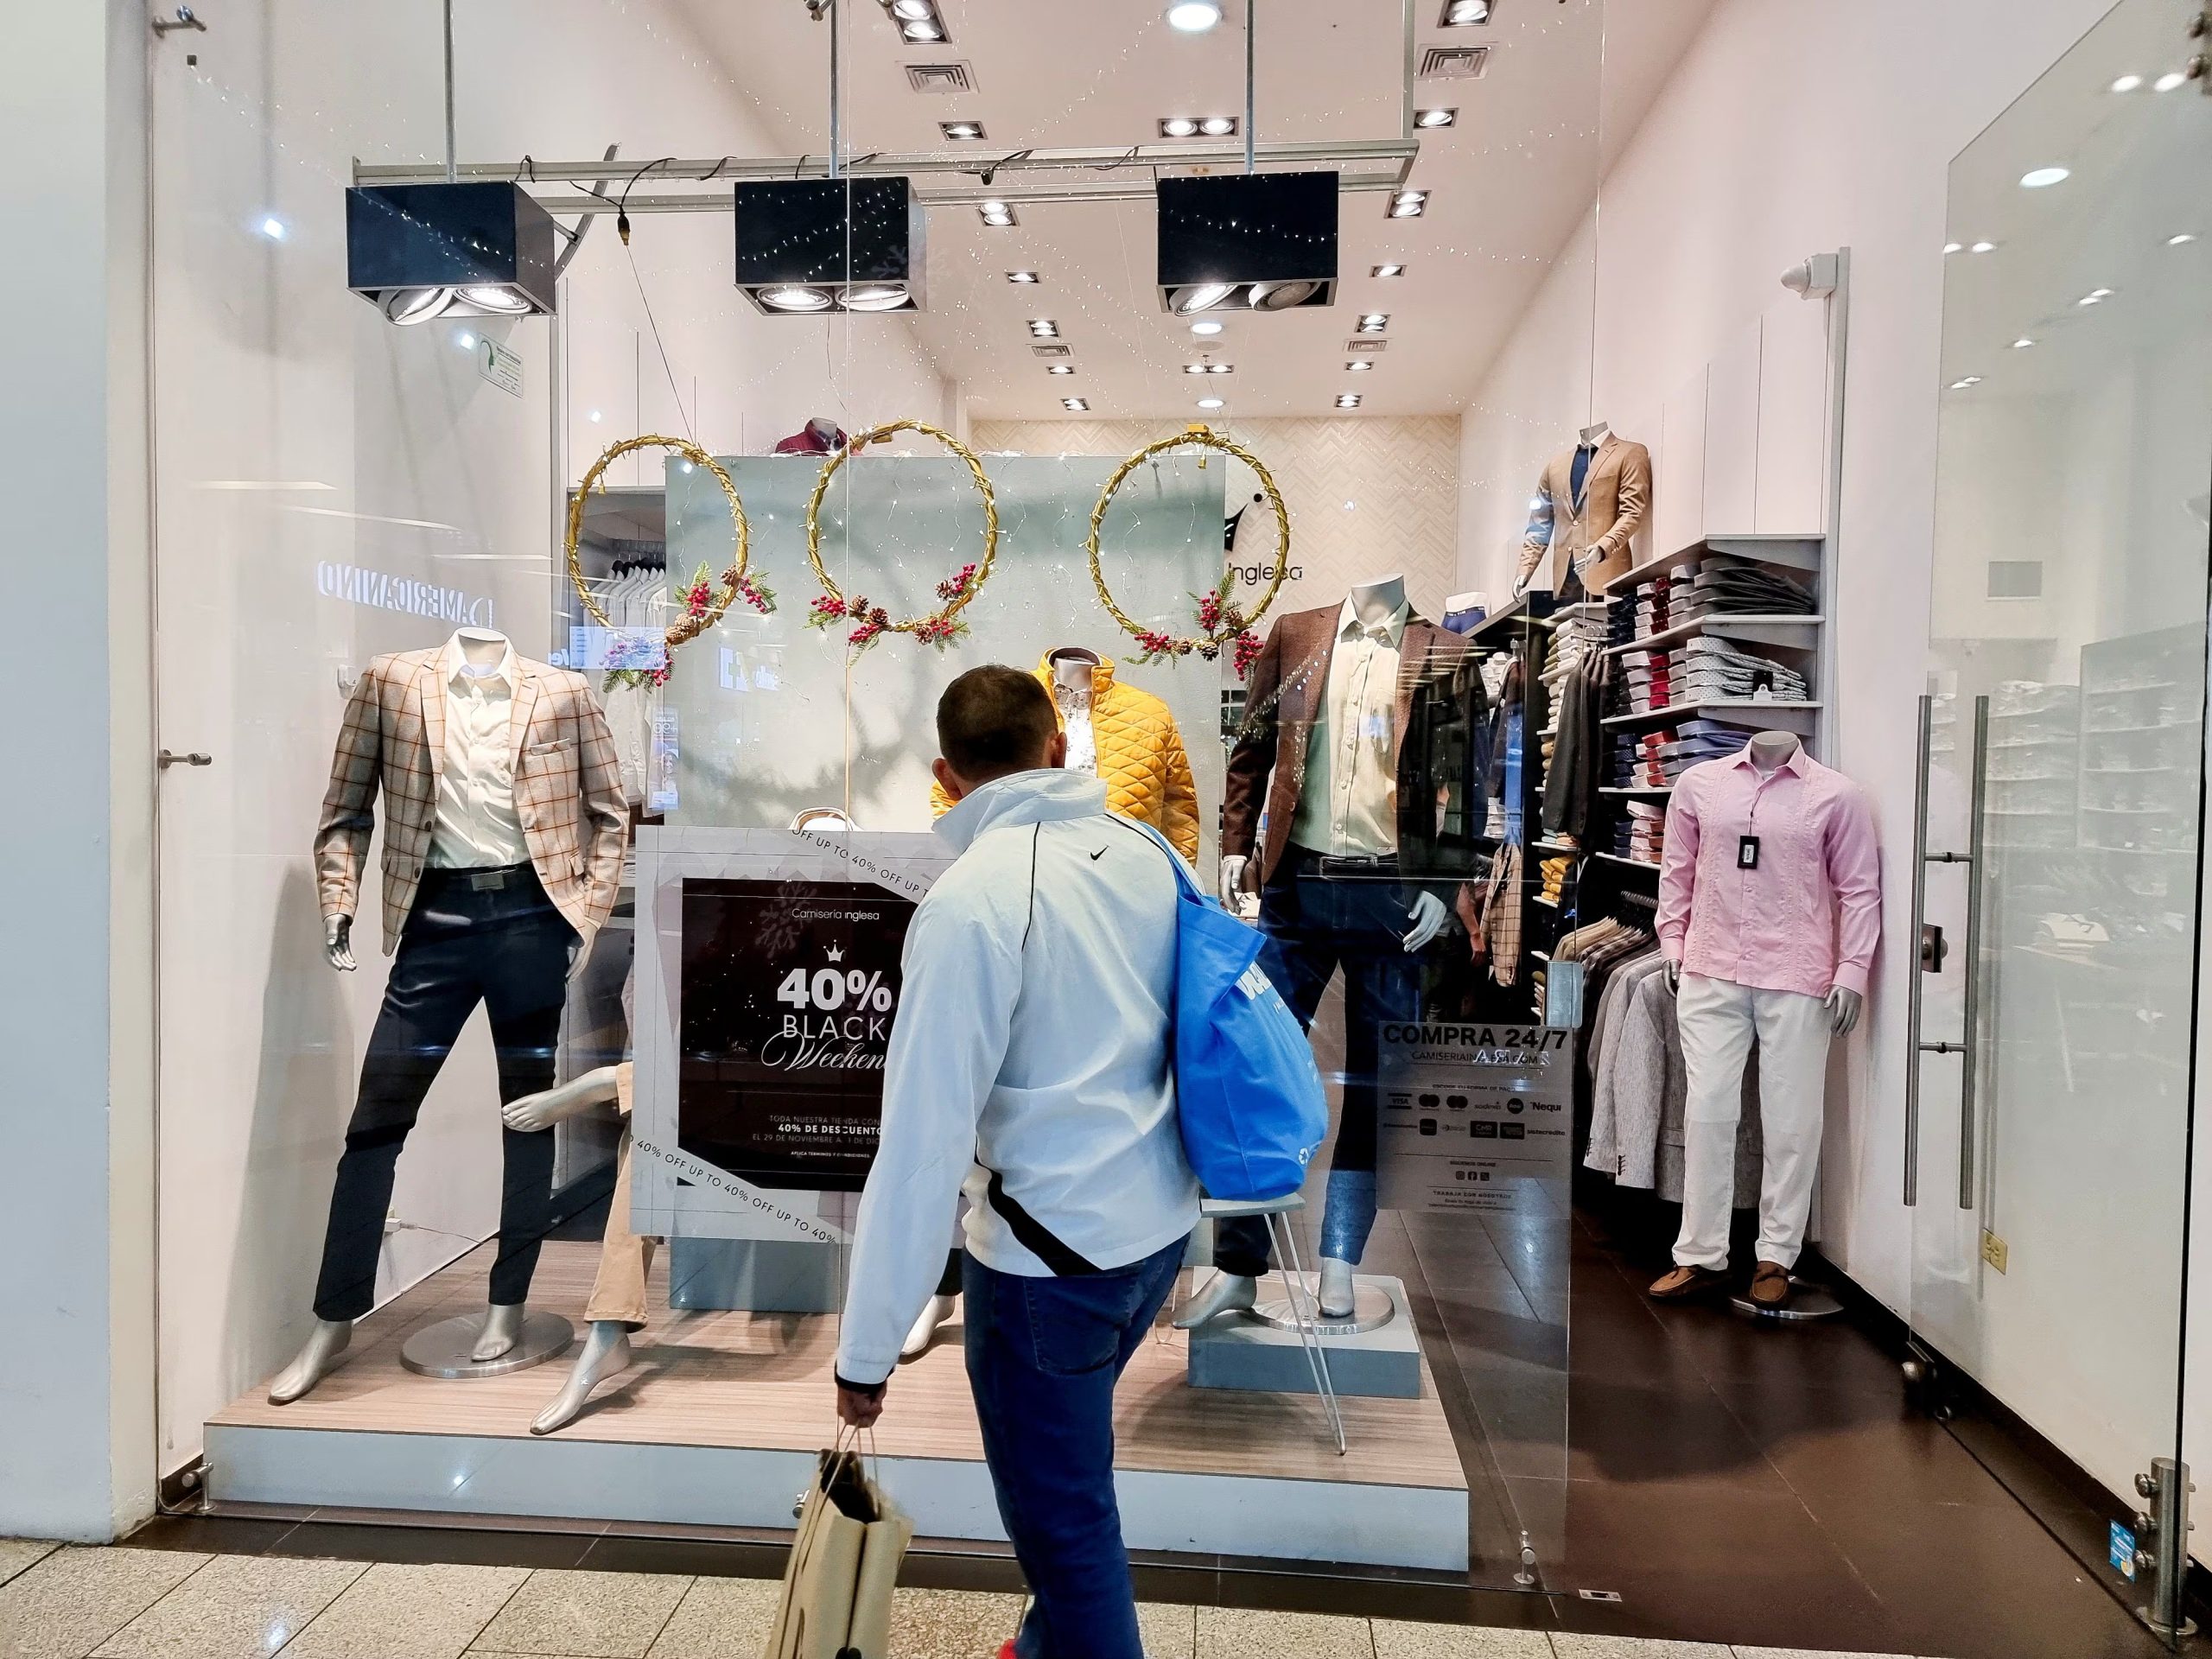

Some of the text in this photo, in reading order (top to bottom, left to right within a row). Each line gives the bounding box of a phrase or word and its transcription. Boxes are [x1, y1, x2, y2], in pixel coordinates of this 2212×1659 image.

[817, 837, 830, 849] UP
[834, 845, 849, 858] TO
[852, 855, 876, 873] 40%
[880, 869, 902, 884] OFF
[905, 880, 919, 893] UP
[844, 910, 880, 922] inglesa
[778, 968, 892, 1012] 40%
[784, 1014, 886, 1041] BLACK
[1383, 1025, 1567, 1052] COMPRA 24/7
[761, 1030, 886, 1071] Weeken
[1532, 1102, 1561, 1112] Nequi
[778, 1124, 801, 1133] 40%
[804, 1125, 817, 1134] DE
[637, 1141, 836, 1244] 40% OFF UP TO 40% OFF UP TO 40%
